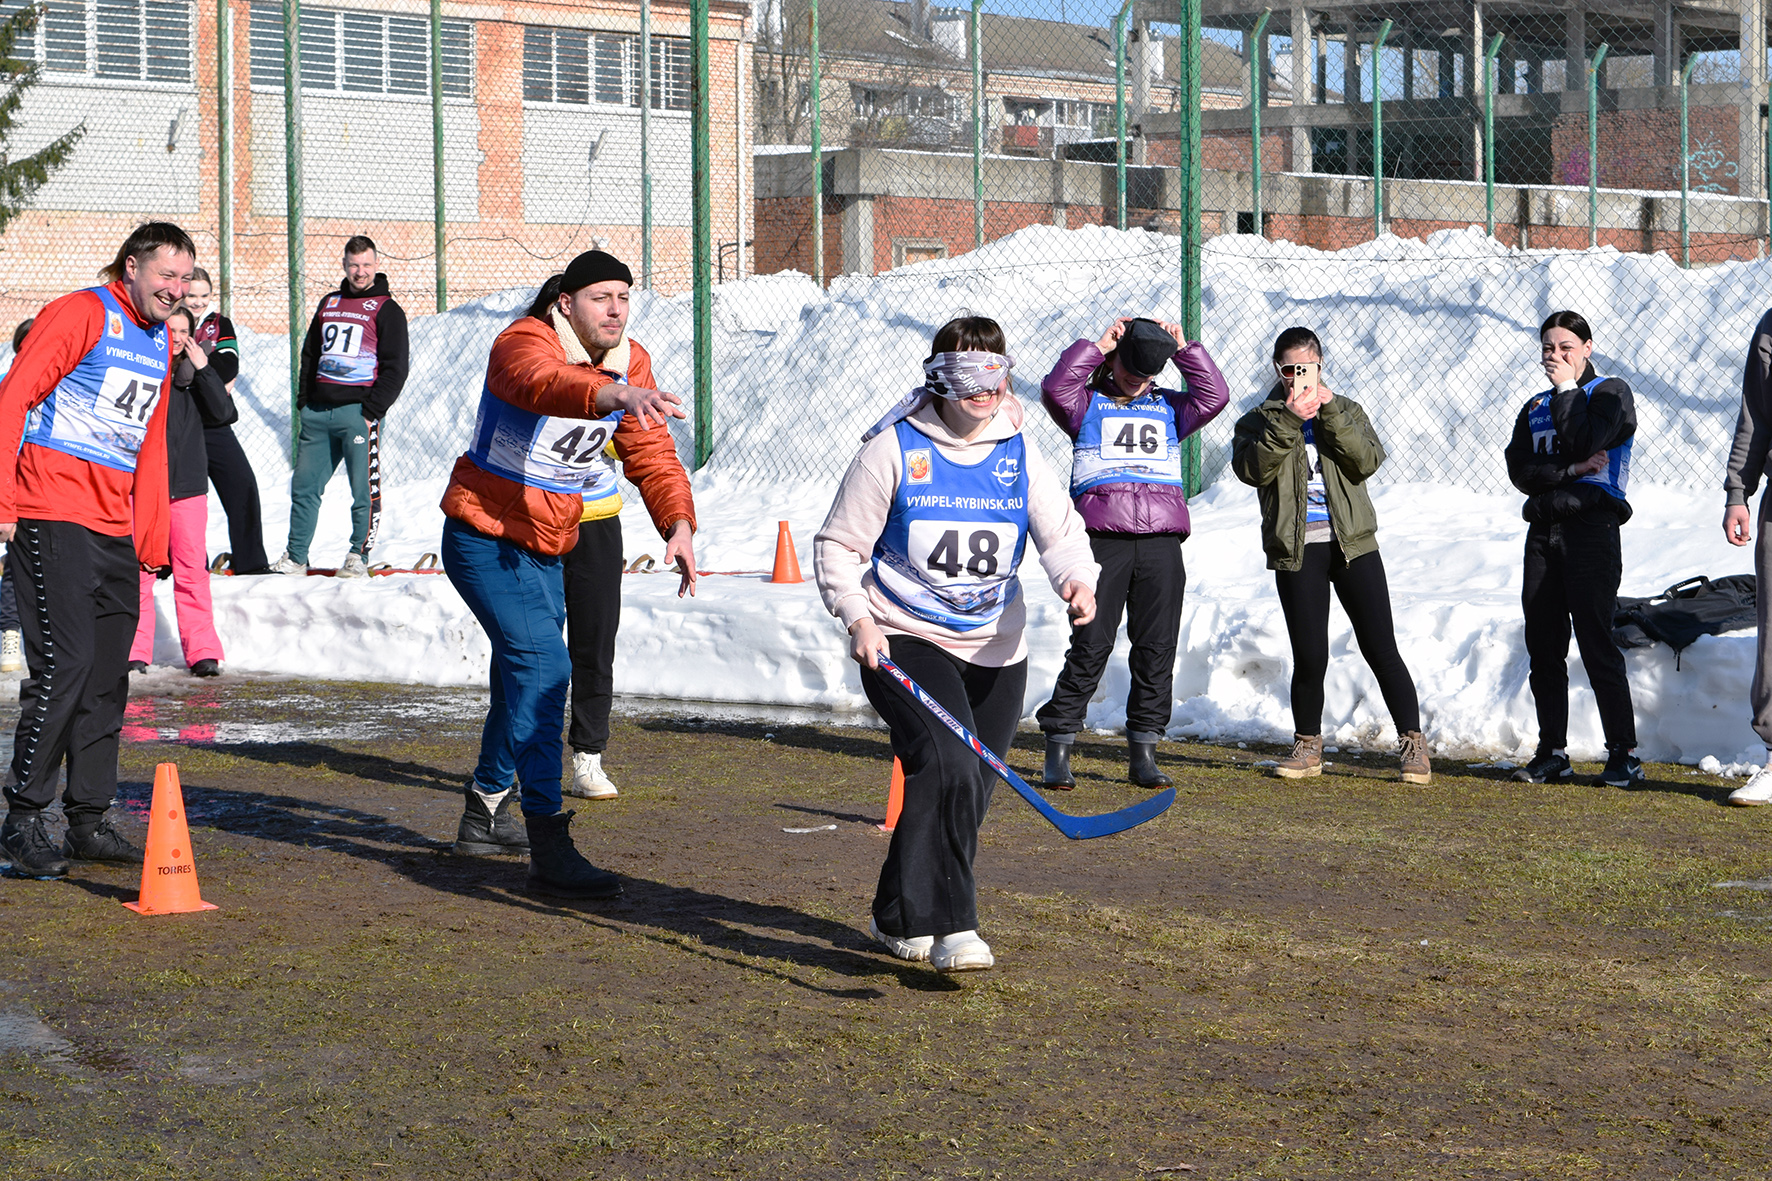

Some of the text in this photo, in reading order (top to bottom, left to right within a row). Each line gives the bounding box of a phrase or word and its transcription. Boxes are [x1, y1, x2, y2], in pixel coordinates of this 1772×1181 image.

[323, 324, 354, 353] 91
[106, 345, 166, 371] VYMPEL-RYBINSK.RU
[114, 379, 158, 422] 47
[551, 425, 607, 463] 42
[1113, 423, 1159, 454] 46
[907, 495, 1023, 510] VYMPEL-RYBINSK.RU
[927, 530, 999, 578] 48
[923, 697, 962, 732] METEOR
[157, 864, 192, 875] TORRES
